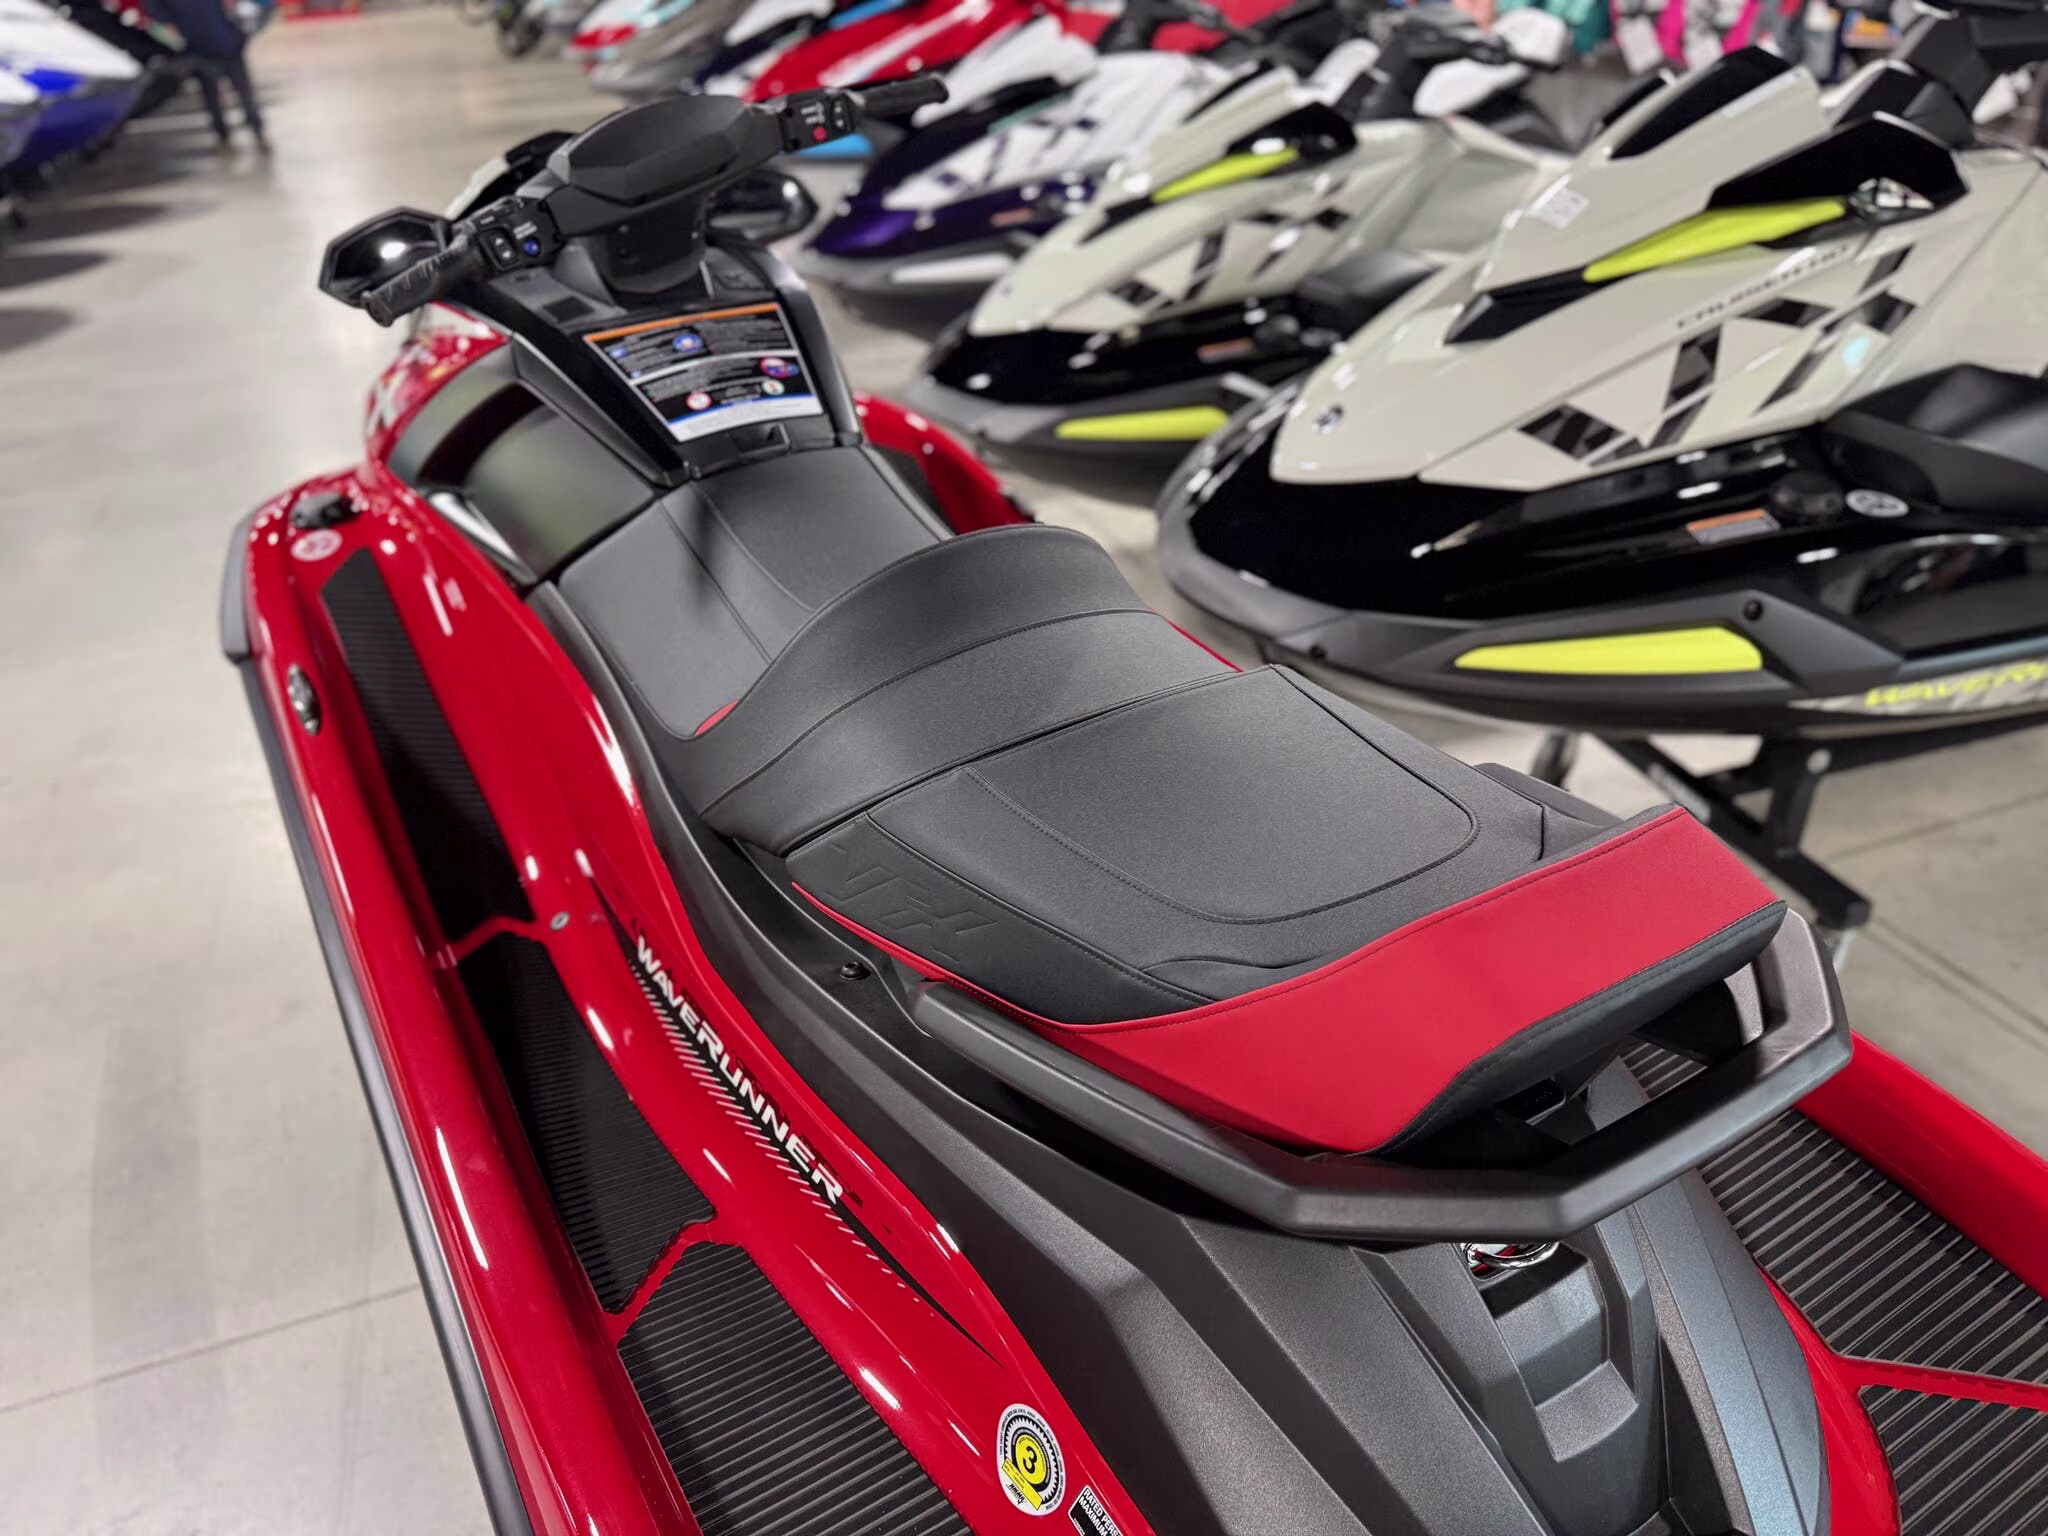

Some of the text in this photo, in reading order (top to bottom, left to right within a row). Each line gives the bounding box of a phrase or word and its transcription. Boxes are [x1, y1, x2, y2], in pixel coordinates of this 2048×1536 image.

[636, 933, 844, 1205] WAVERUNNER
[1022, 1445, 1038, 1475] 3
[1078, 1496, 1109, 1536] MAXIMUM
[1083, 1489, 1104, 1517] RATED
